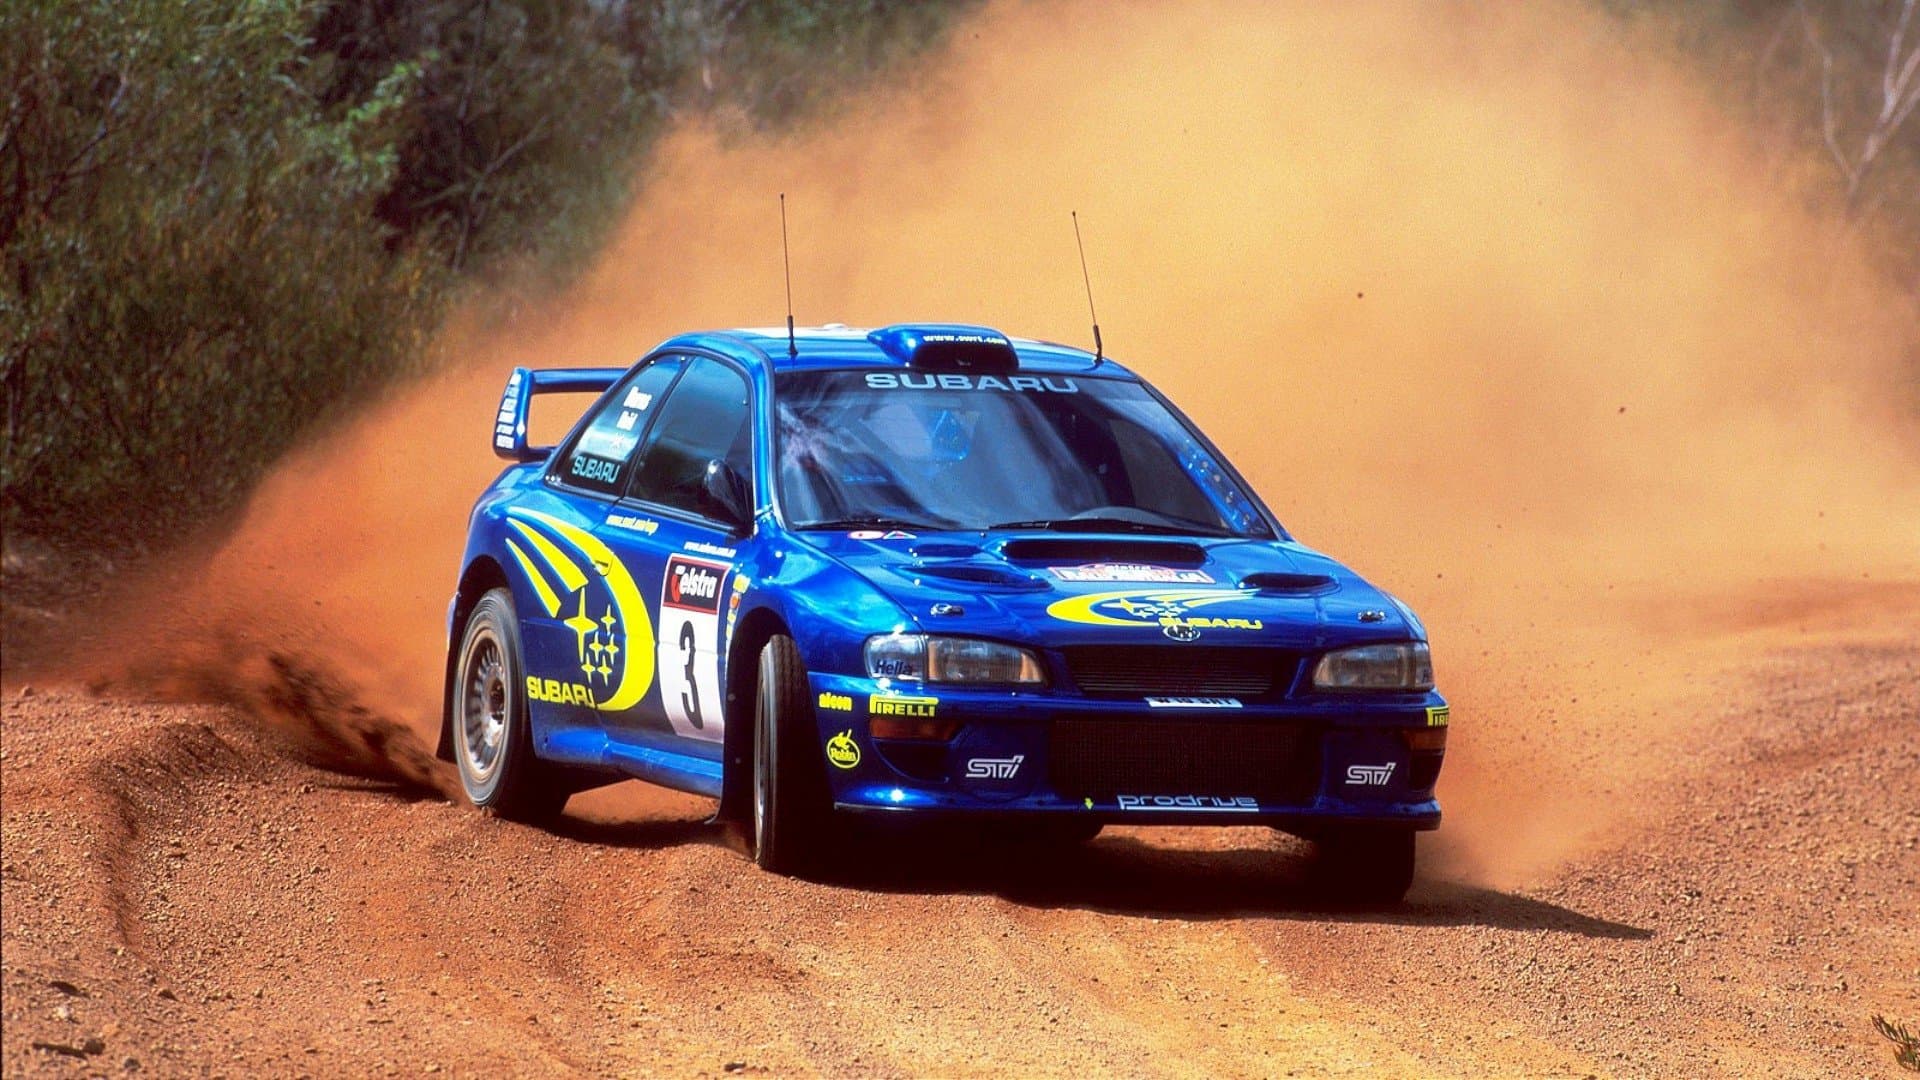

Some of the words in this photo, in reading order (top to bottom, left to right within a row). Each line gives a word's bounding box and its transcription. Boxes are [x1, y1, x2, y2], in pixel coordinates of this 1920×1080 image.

[865, 373, 1079, 393] SUBARU
[571, 455, 620, 484] SUBARU
[1159, 617, 1263, 630] SUBARU
[680, 620, 704, 730] 3
[875, 659, 913, 676] Hella
[526, 676, 596, 709] SUBARU
[869, 694, 939, 717] PIRELLI
[1117, 795, 1260, 812] prodrive
